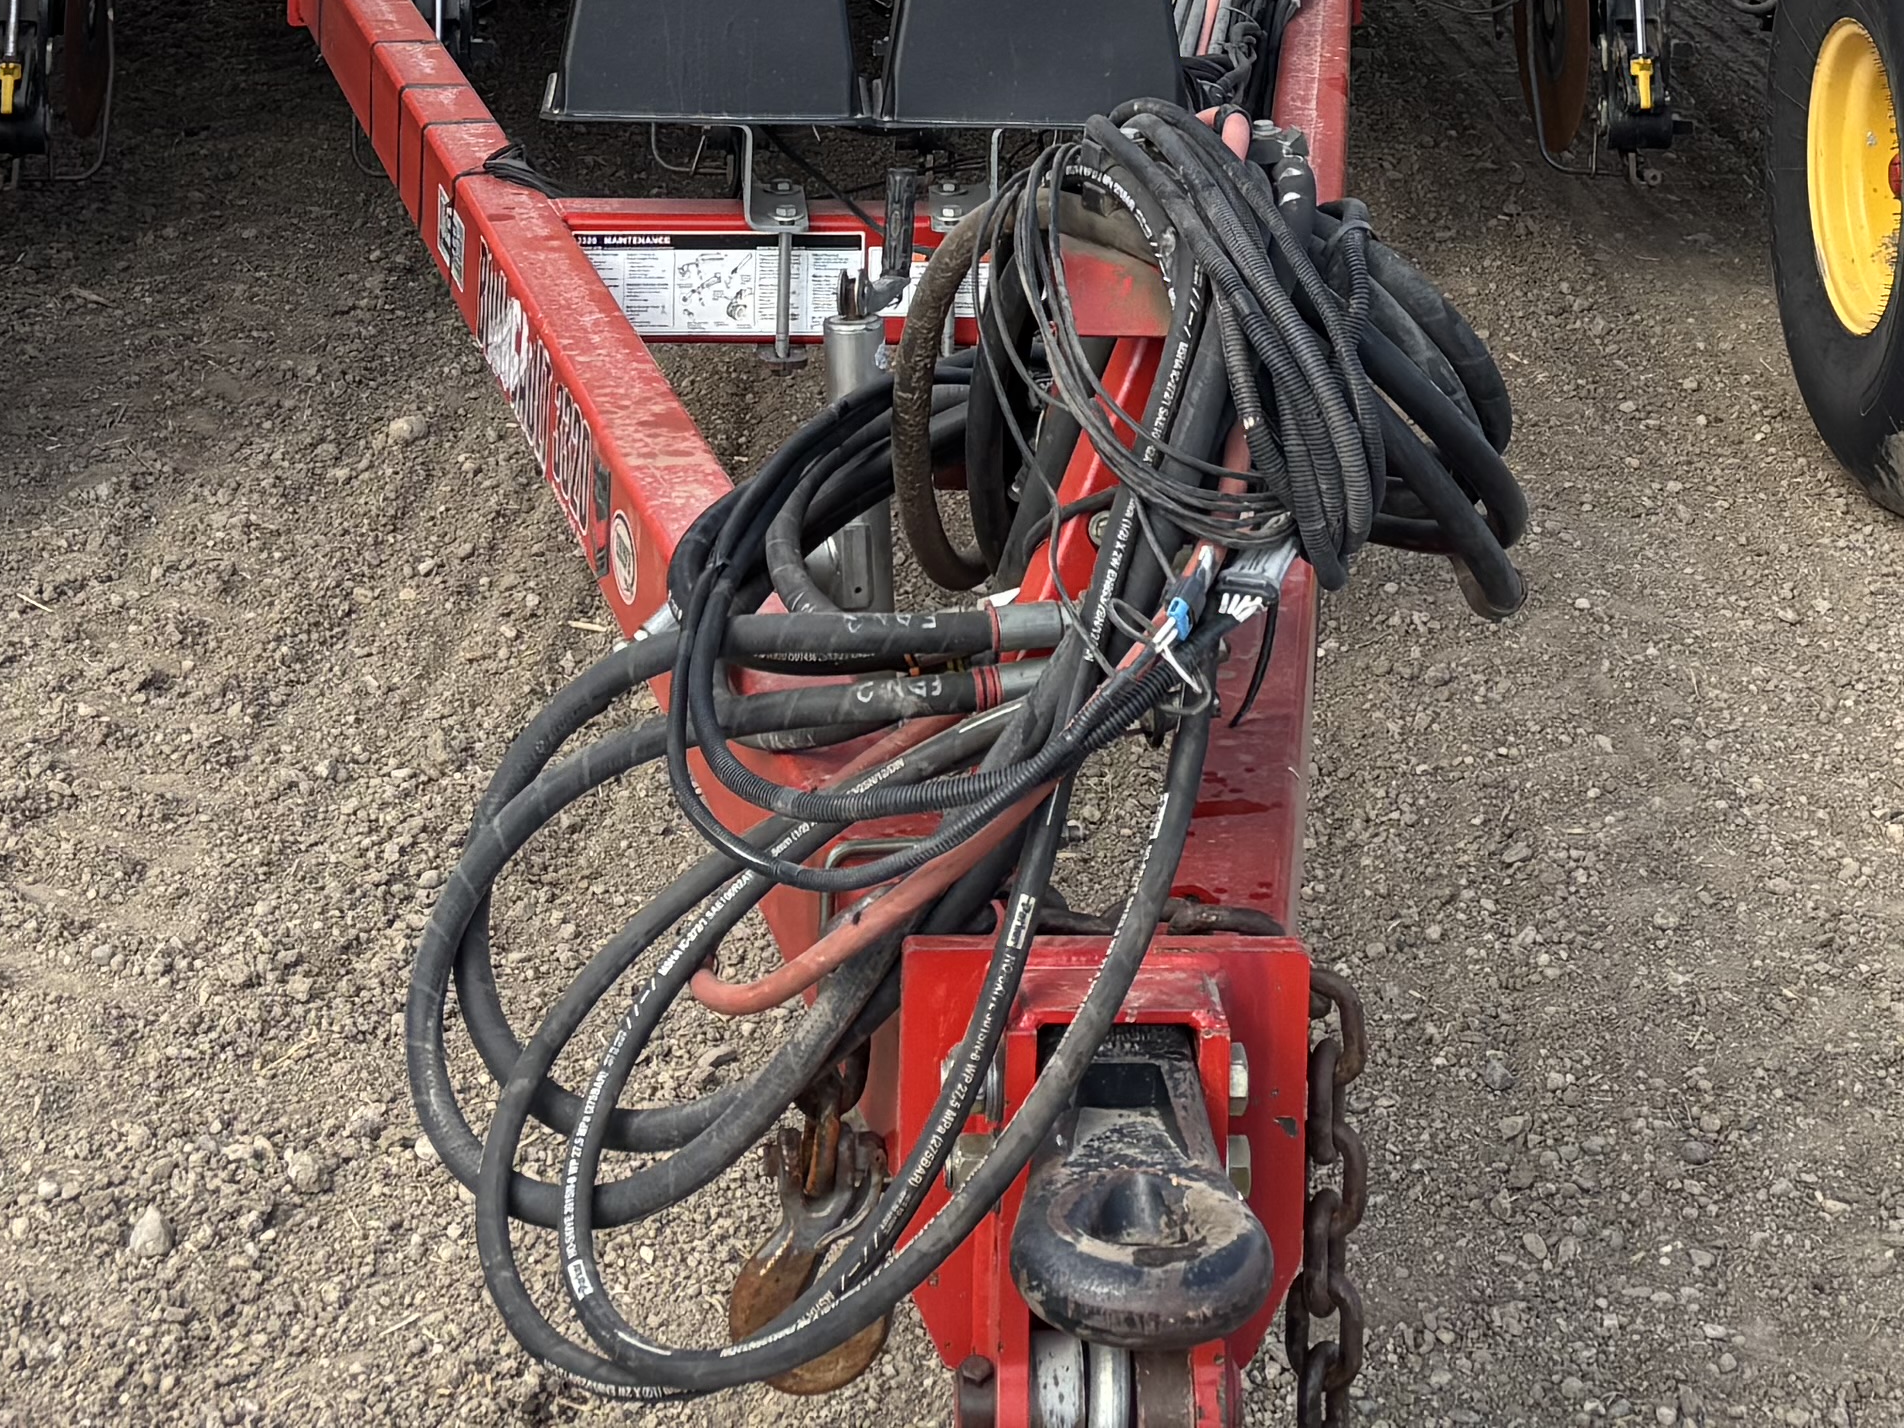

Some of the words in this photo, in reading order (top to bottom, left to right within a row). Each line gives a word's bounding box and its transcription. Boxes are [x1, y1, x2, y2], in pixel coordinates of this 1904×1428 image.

[604, 236, 671, 245] MAINTENANCE
[963, 1062, 978, 1084] WP
[952, 1083, 969, 1109] 27,5
[940, 1105, 958, 1135] MPa
[908, 1134, 944, 1188] (275BAR)
